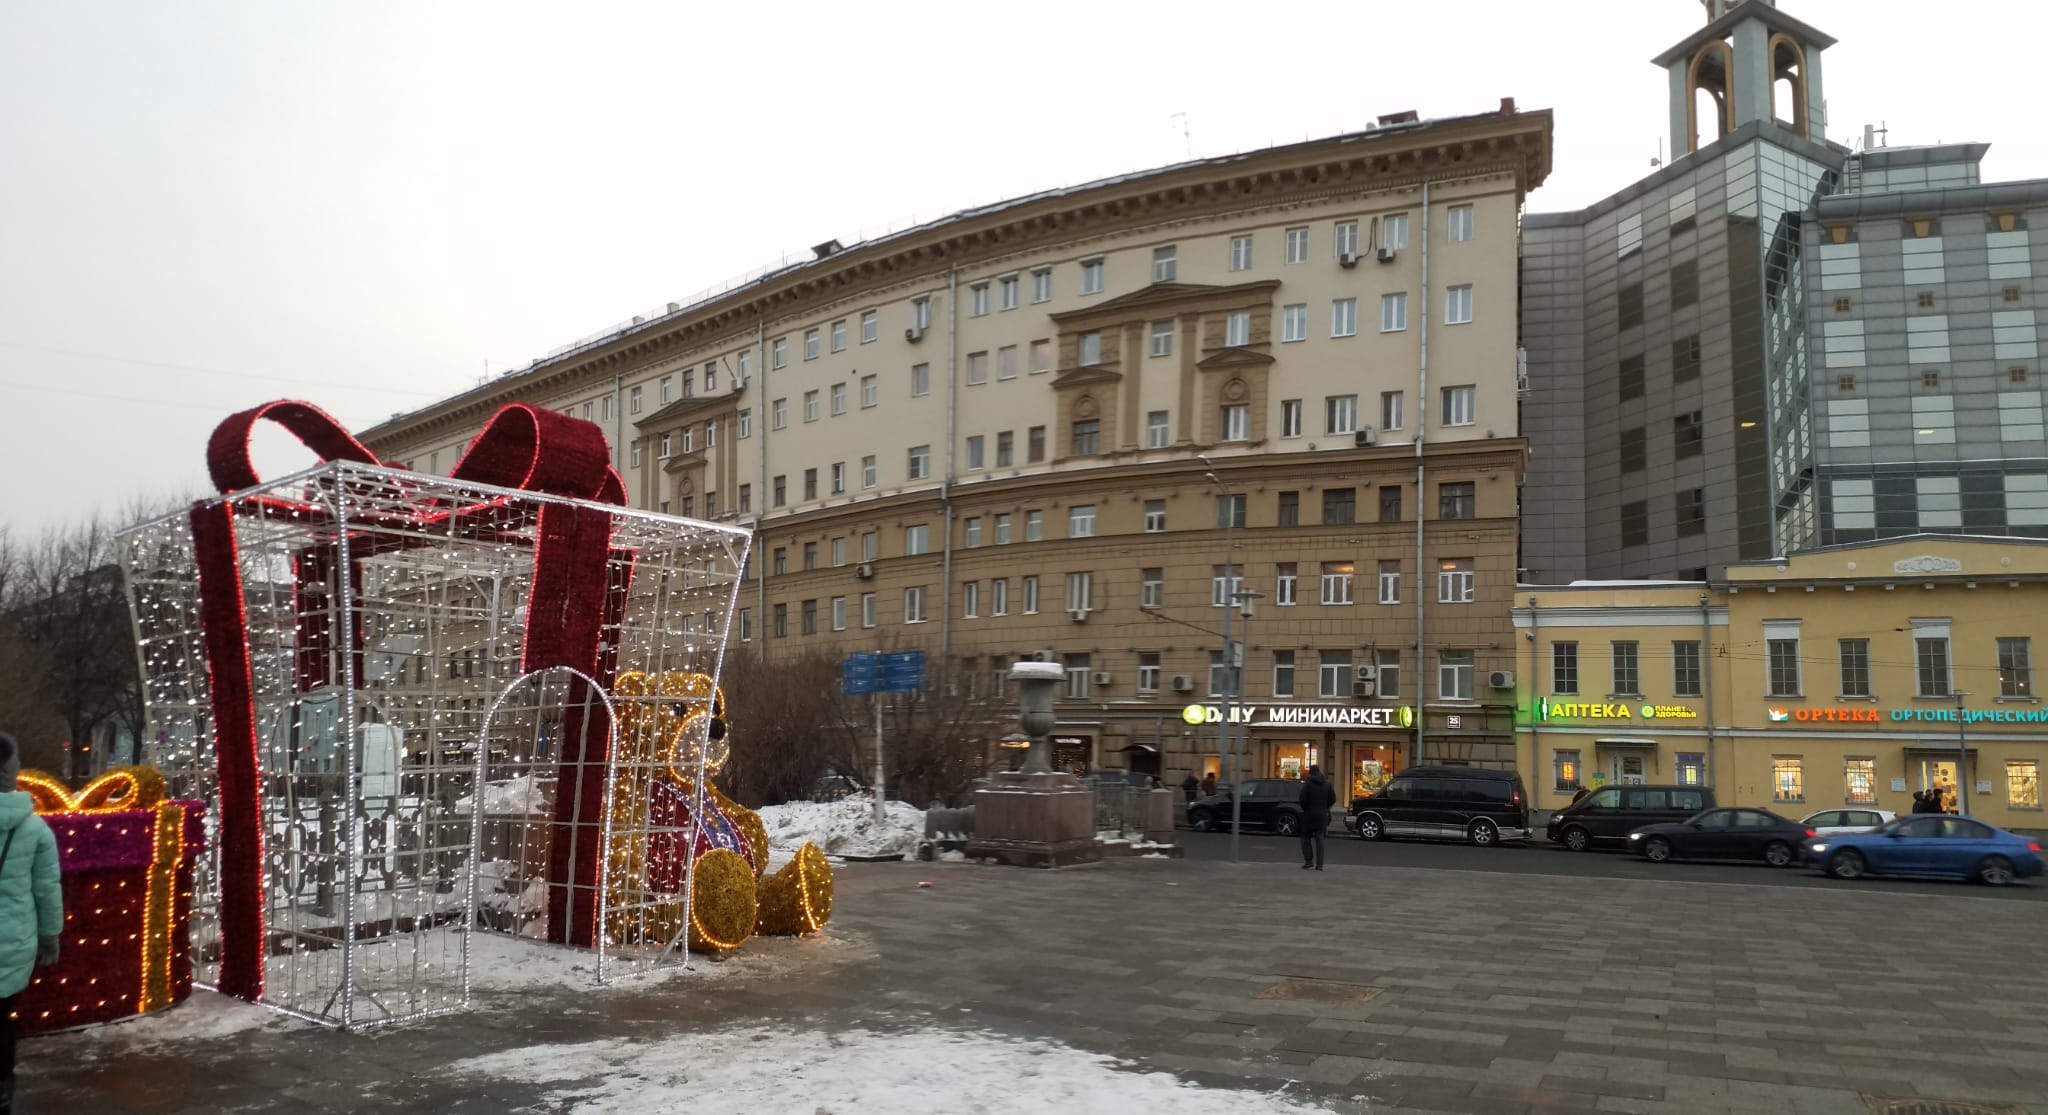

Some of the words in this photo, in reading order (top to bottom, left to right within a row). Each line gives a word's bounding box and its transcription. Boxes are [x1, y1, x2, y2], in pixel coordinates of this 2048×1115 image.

[1269, 706, 1394, 724] МИНИМАРКЕТ
[1551, 703, 1631, 719] АПТЕКА
[1794, 707, 1880, 722] ОРТЕКА
[1890, 706, 2048, 724] ОРТОПЕДИЧЕСКИЙ
